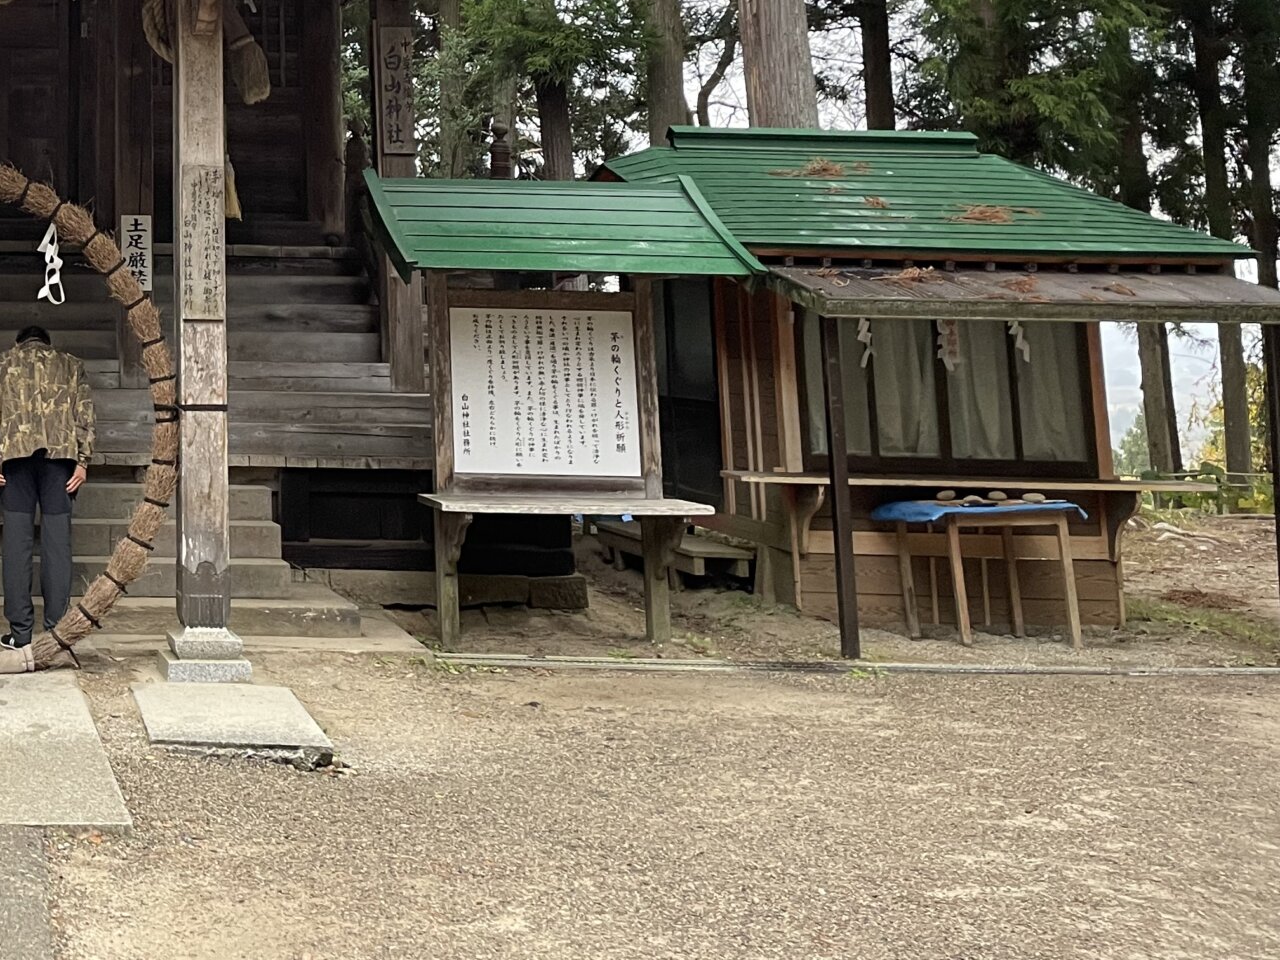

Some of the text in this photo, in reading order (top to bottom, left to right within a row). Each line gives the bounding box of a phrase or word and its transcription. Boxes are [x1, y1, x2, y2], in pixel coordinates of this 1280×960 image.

[384, 44, 404, 144] 白山神社
[183, 215, 193, 310] 白山神社社務所
[461, 394, 471, 455] 白山神社社務所
[609, 332, 626, 453] 茅の輪くぐりと人形祈願
